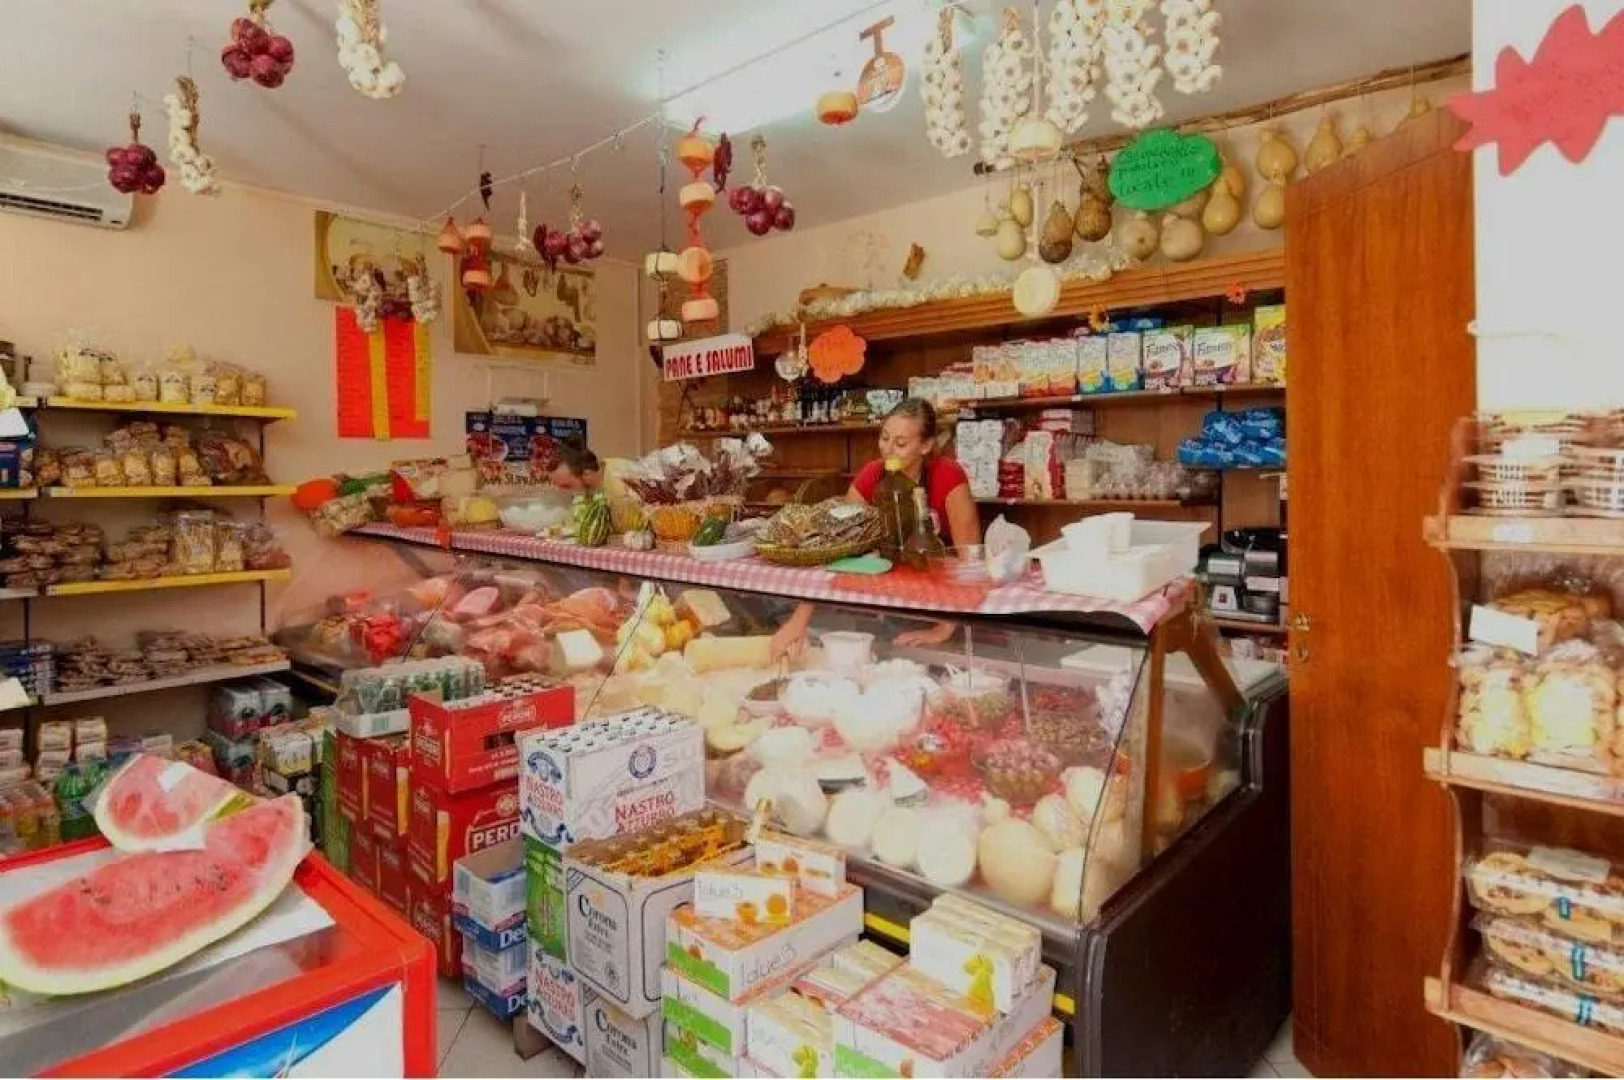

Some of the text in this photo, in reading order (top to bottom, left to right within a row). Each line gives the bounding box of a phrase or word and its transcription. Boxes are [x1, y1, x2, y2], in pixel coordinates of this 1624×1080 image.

[665, 345, 752, 379] PANE E SALUMI
[614, 790, 674, 821] NASTRO
[578, 894, 617, 931] Corona
[595, 1008, 637, 1050] Corona
